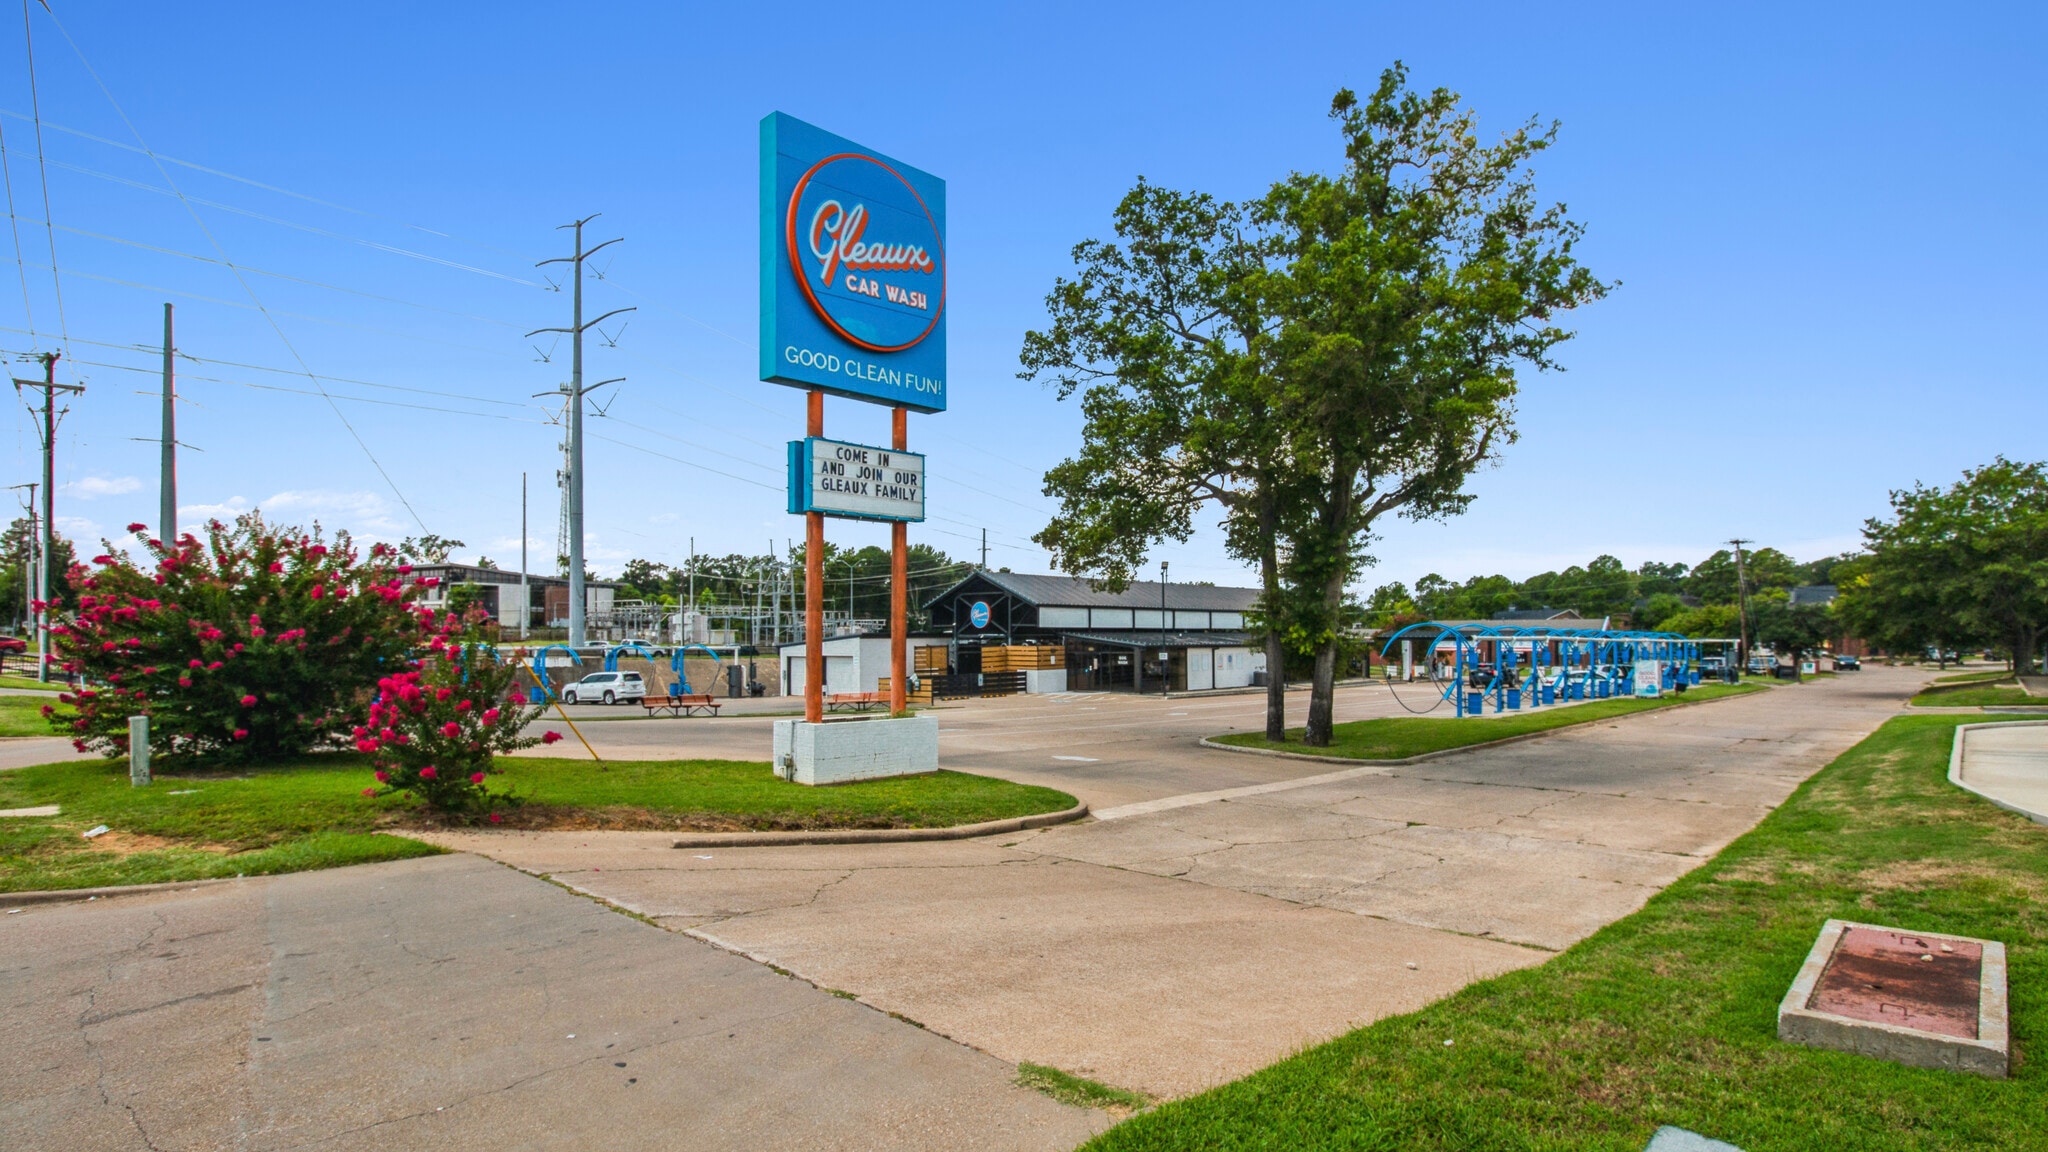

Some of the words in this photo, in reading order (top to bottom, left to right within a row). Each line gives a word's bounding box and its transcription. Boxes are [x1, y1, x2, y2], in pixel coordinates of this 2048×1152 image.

[809, 199, 933, 286] Gleaux
[845, 274, 880, 298] CAR
[885, 285, 927, 310] WASH
[785, 345, 840, 373] GOOD
[844, 360, 901, 386] CLEAN
[905, 373, 942, 395] FUN!
[836, 447, 868, 464] COME
[878, 454, 889, 466] IN
[821, 461, 845, 476] AND
[856, 466, 883, 482] JOIN
[895, 472, 917, 486] OUR
[821, 478, 868, 495] GLEAUX
[875, 484, 917, 501] FAMILY
